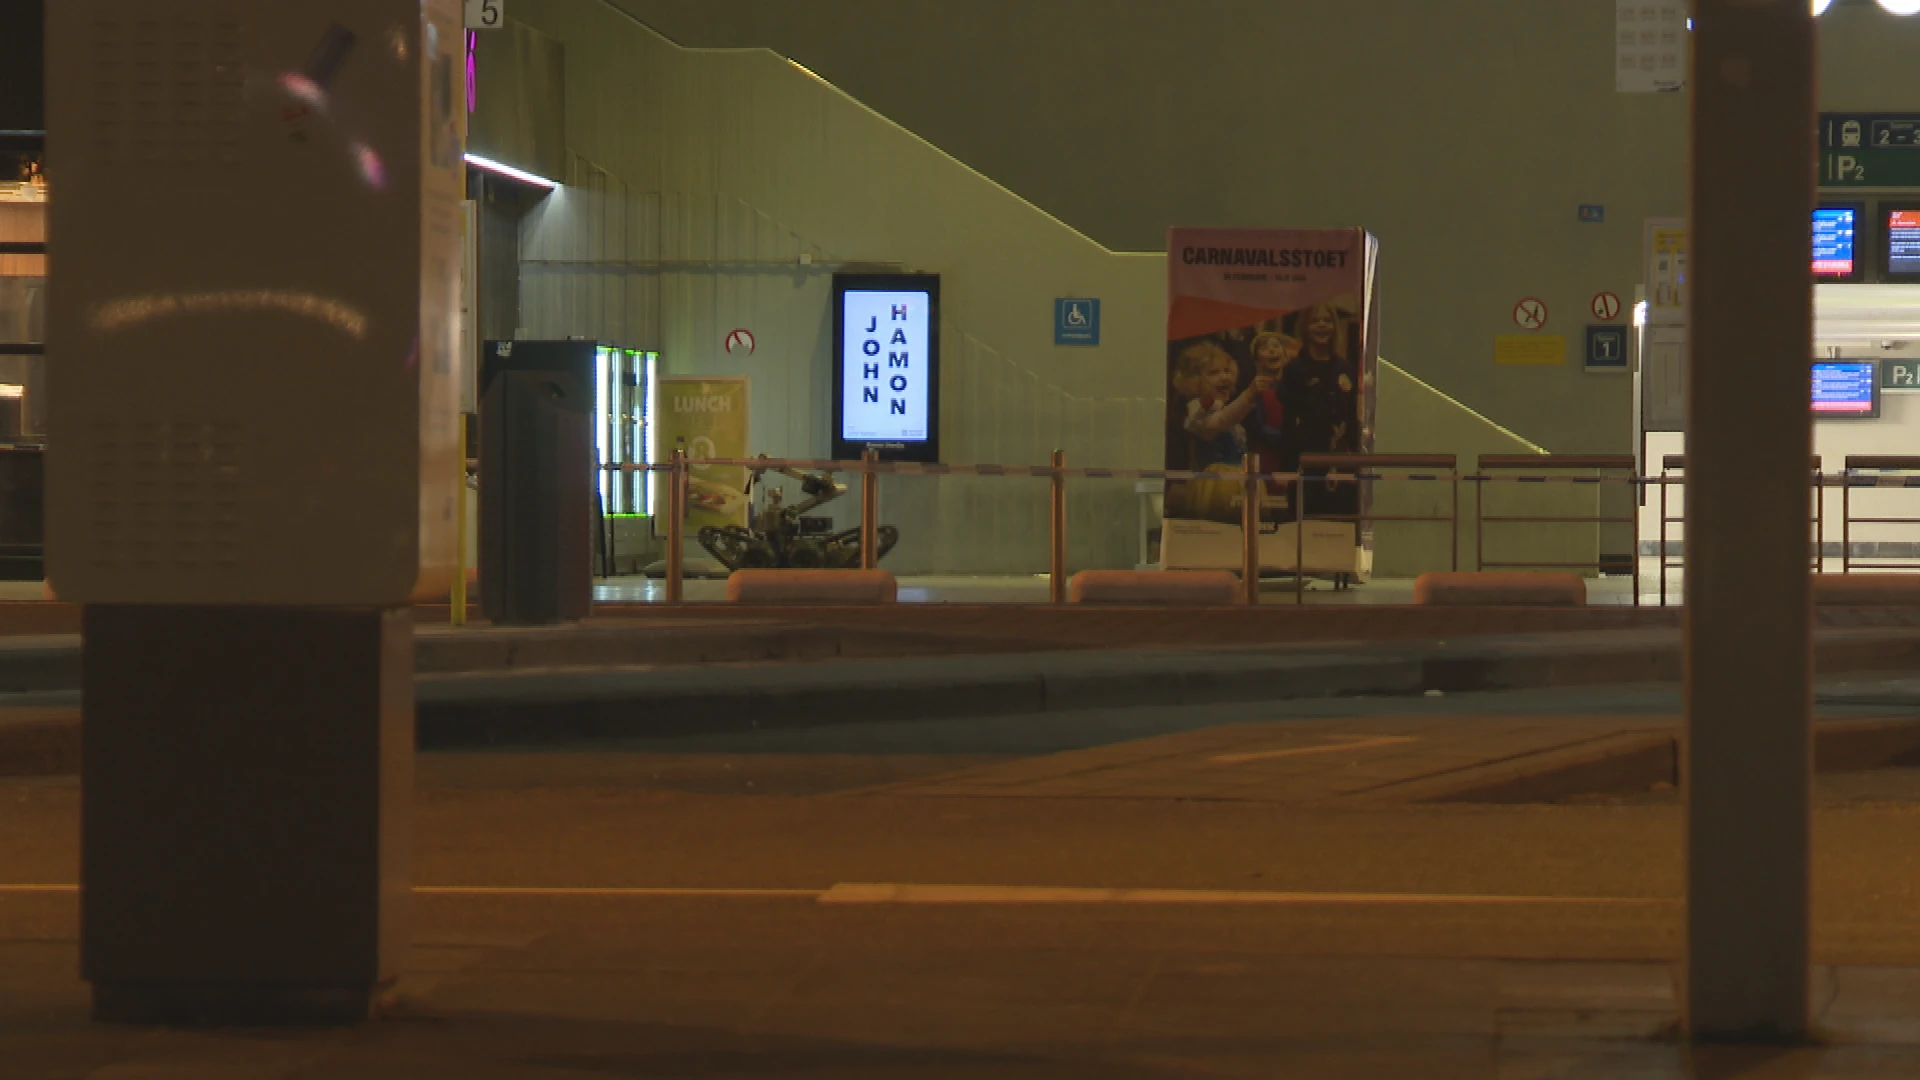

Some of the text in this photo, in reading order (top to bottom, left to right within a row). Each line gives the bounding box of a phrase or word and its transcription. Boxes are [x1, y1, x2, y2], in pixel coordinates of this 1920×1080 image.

[481, 0, 498, 25] 5
[1880, 129, 1890, 145] 2
[1838, 155, 1864, 180] P2
[1182, 246, 1348, 268] CARNAVALSSTOET
[862, 315, 881, 403] JOHN
[888, 303, 909, 415] HAMON
[1602, 341, 1610, 357] 1
[1893, 365, 1913, 385] P2
[673, 395, 732, 413] LUNCH
